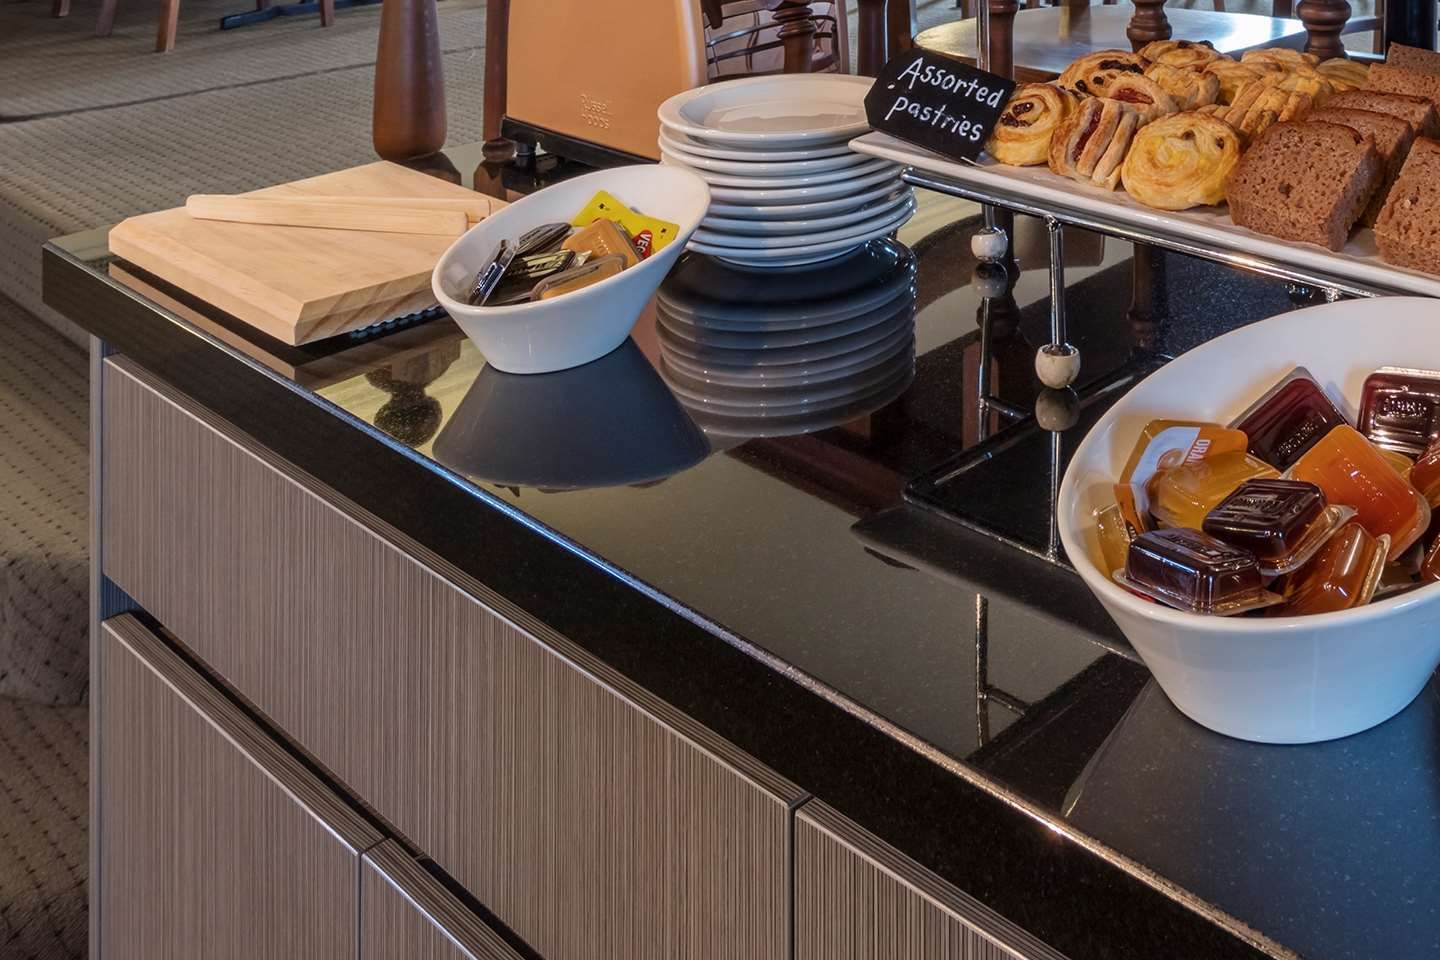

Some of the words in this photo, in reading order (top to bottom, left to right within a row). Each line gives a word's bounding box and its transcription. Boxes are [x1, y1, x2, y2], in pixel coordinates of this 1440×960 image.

[898, 57, 1005, 108] Assorted
[884, 96, 984, 141] pastries
[1185, 439, 1211, 464] ORA
